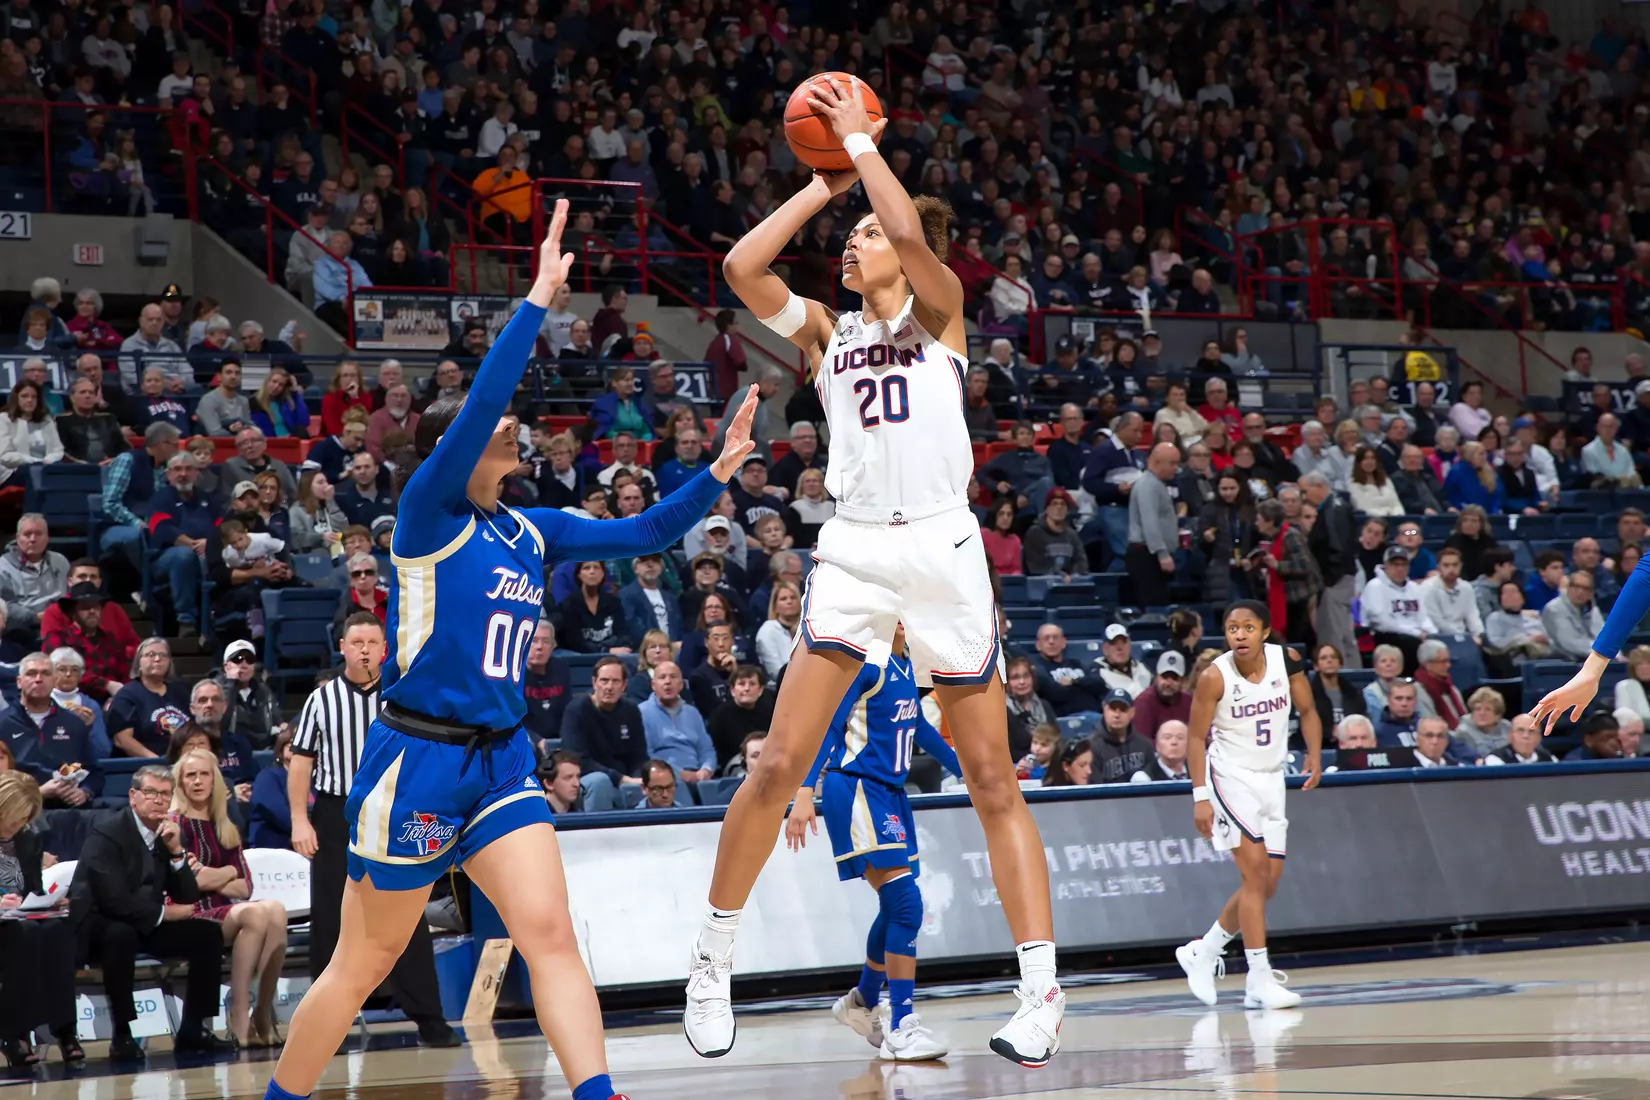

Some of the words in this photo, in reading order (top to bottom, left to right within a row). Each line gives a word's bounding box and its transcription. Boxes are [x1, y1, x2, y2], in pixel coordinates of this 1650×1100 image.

[1, 213, 28, 236] 21
[79, 245, 100, 263] EXIT
[834, 343, 926, 375] UCONN
[853, 374, 910, 429] 20
[486, 566, 544, 606] Tulsa
[481, 610, 534, 685] 00
[1231, 693, 1288, 719] UCONN
[1256, 719, 1271, 747] 5
[397, 820, 455, 843] Tulsa
[1526, 800, 1650, 845] UCON
[258, 871, 310, 881] TICKE
[1056, 876, 1166, 900] ATHLETICS
